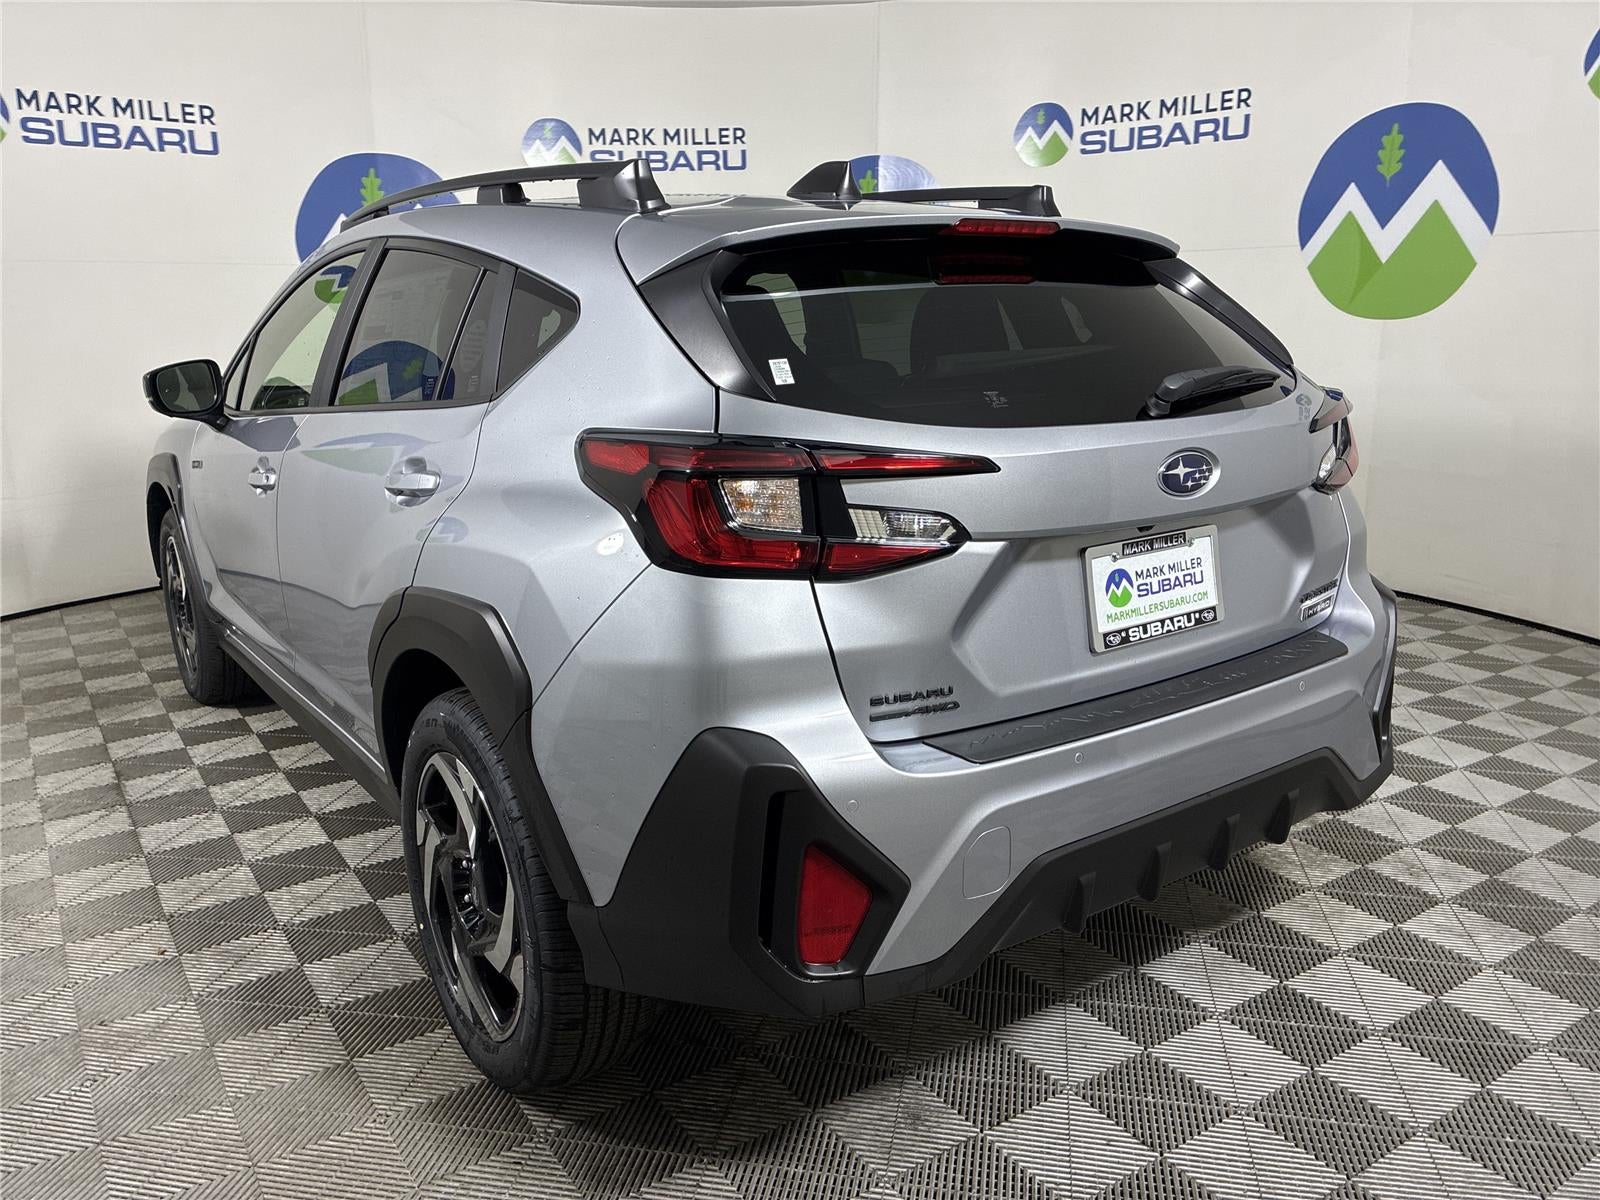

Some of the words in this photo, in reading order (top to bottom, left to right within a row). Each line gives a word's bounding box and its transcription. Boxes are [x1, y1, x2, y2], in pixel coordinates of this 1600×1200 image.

[15, 88, 104, 117] MARK
[112, 97, 216, 126] MILLER
[1080, 100, 1151, 126] MARK
[1159, 87, 1252, 118] MILLER
[20, 116, 220, 155] SUBARU
[588, 127, 656, 146] MARK
[663, 127, 746, 146] MILLER
[1080, 114, 1251, 155] SUBARU
[1123, 541, 1151, 556] MARK
[1153, 534, 1185, 549] MILLER
[1135, 565, 1165, 582] MARK
[1168, 557, 1203, 574] MILLER
[1137, 570, 1204, 598] SUBARU
[1106, 591, 1209, 624] MARKMILLERSUBARU.COM
[1128, 612, 1196, 642] SUBARU
[869, 685, 954, 707] SUBARU
